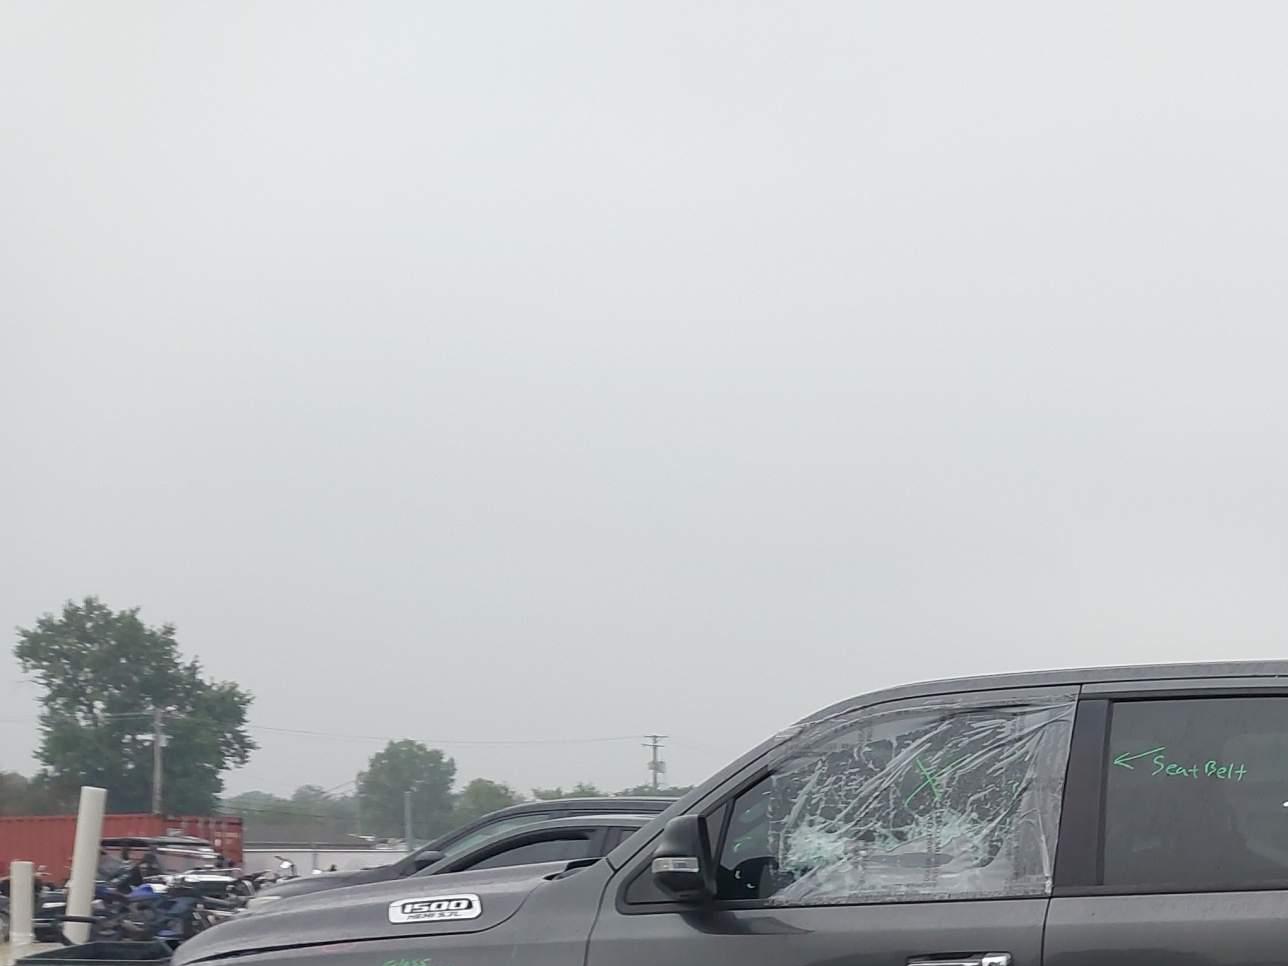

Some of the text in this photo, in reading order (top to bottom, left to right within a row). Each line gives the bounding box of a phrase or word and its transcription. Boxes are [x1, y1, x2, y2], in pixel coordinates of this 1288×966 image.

[1151, 755, 1248, 781] Seat Belt
[403, 899, 469, 914] 1500
